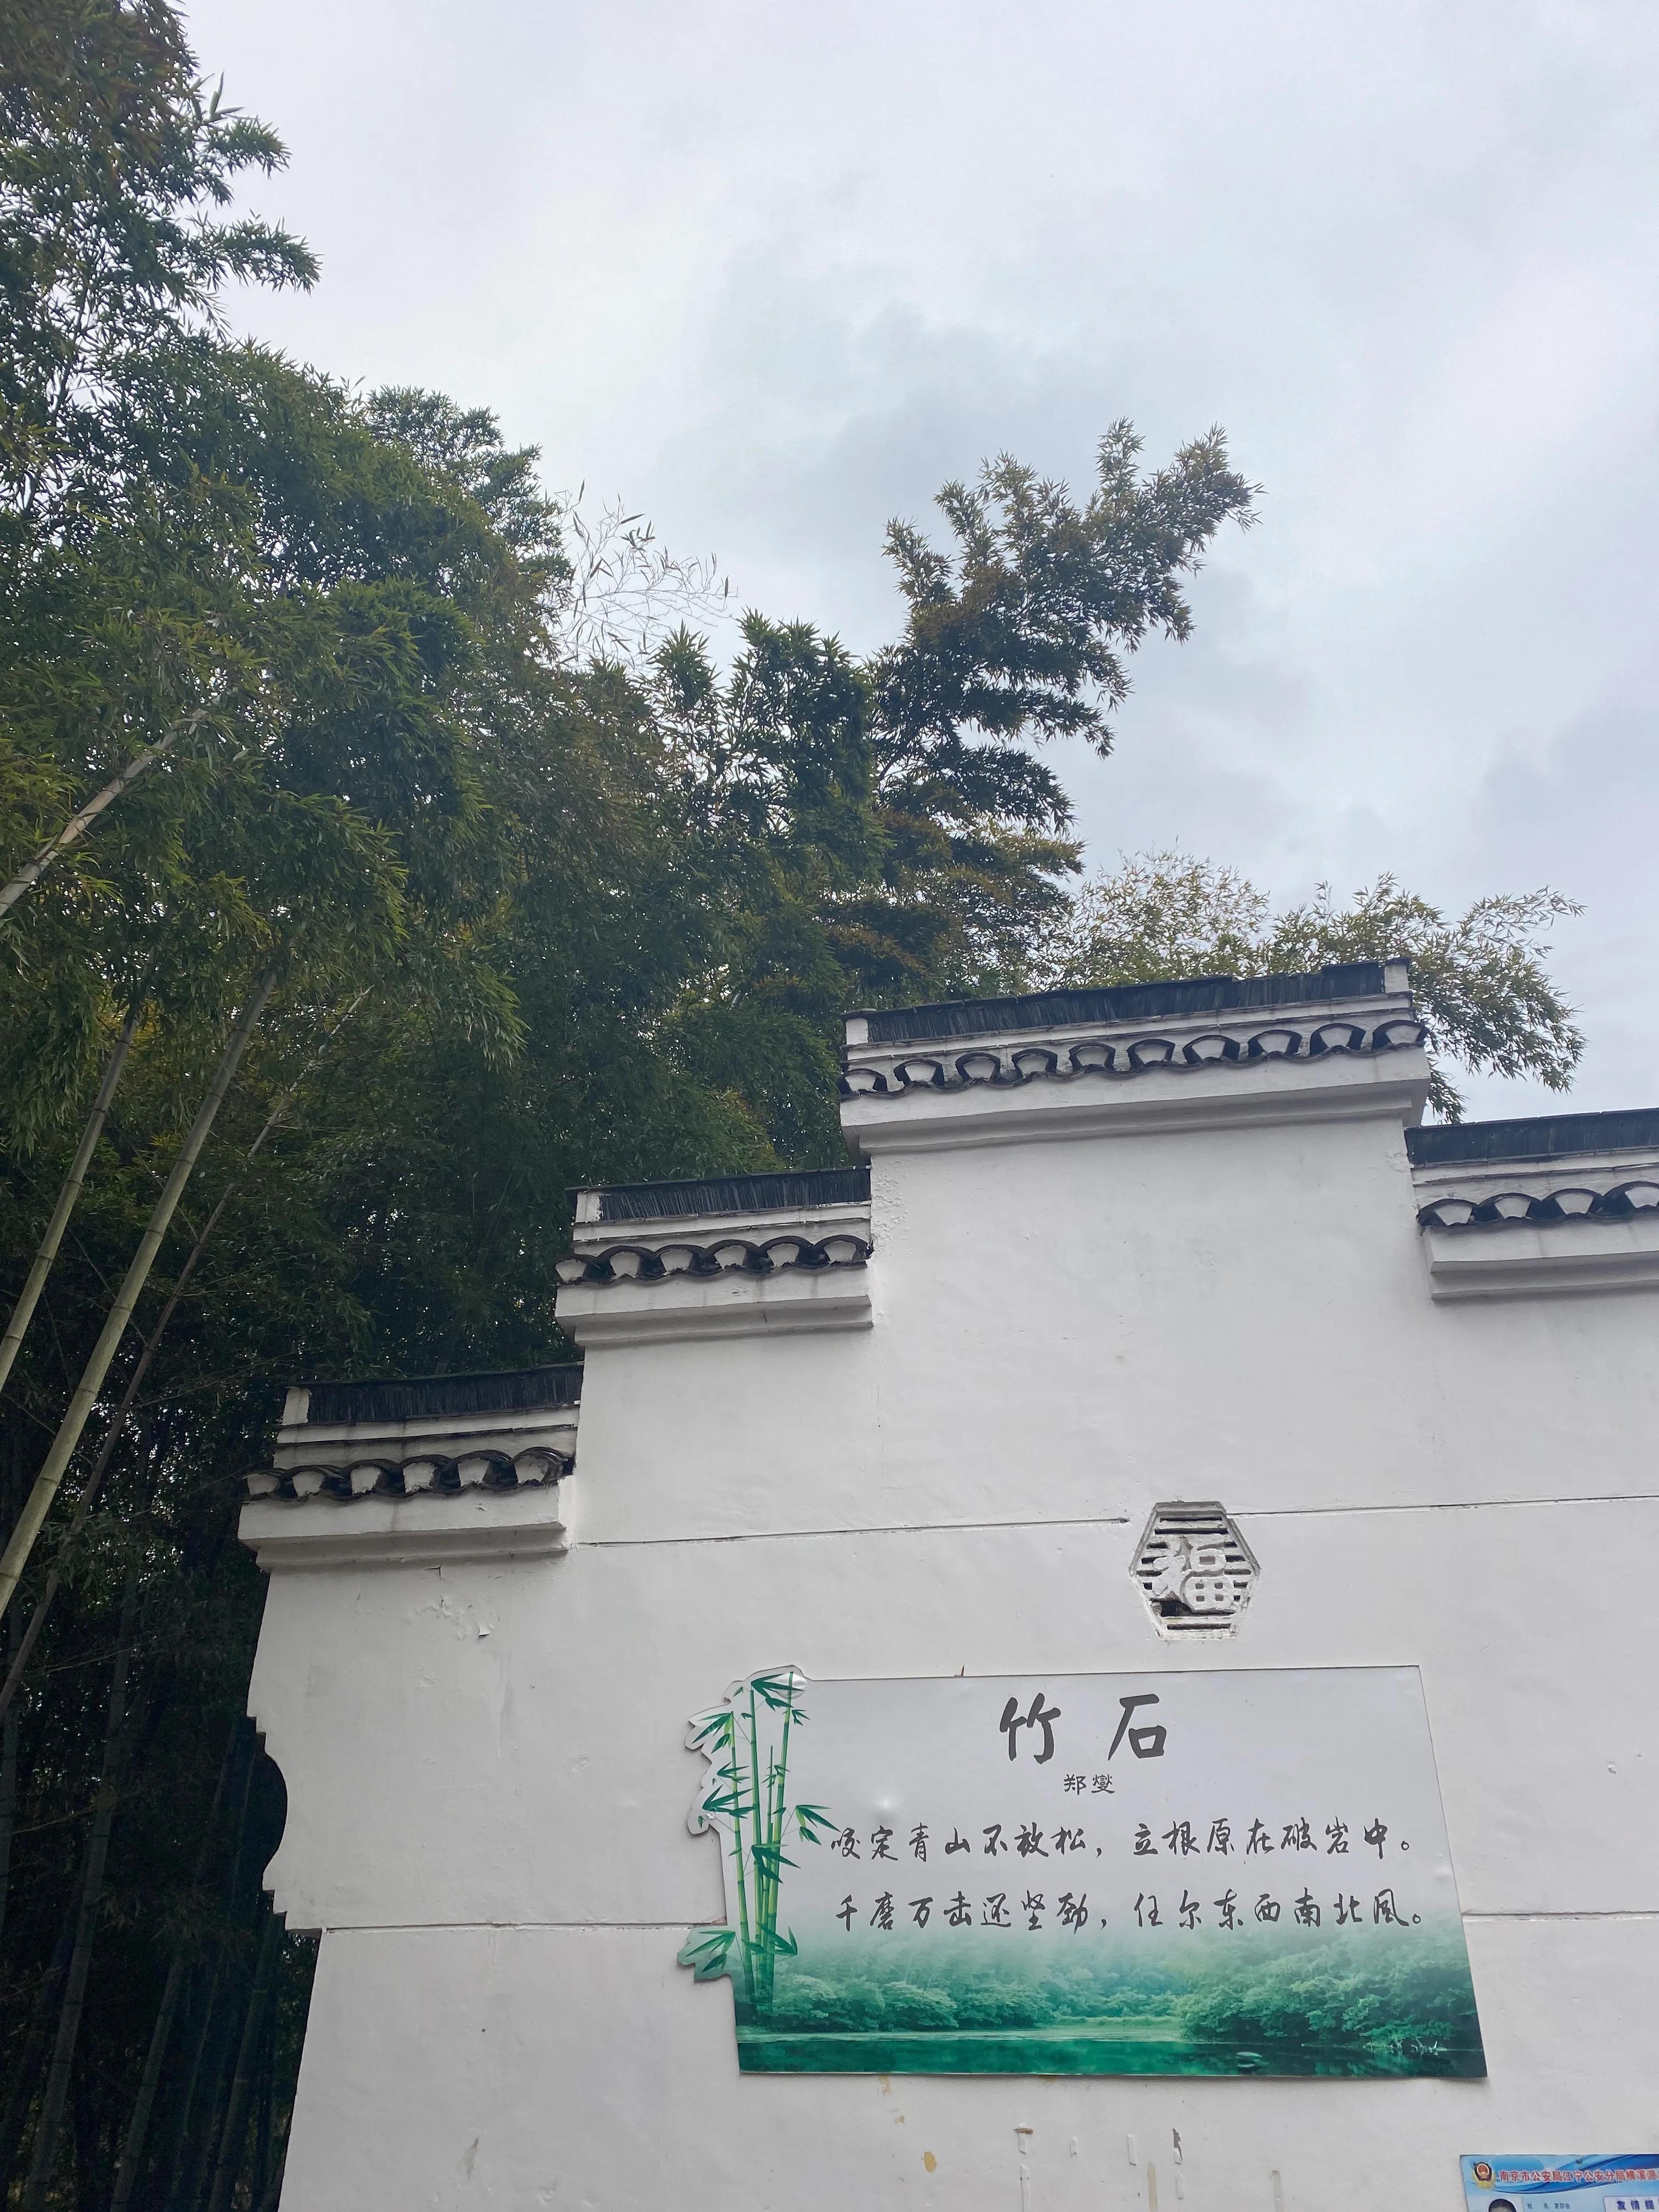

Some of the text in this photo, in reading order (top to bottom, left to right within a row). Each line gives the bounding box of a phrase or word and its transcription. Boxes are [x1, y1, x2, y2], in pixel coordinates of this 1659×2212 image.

[1152, 1533, 1234, 1610] 福
[999, 1692, 1167, 1764] 竹石
[1063, 1774, 1115, 1796] 郑燮
[831, 1816, 1410, 1862] 咬定青山不放松，立根原在破岩中。
[836, 1887, 1421, 1935] 千磨万击还坚劲，任尔东西南北风。
